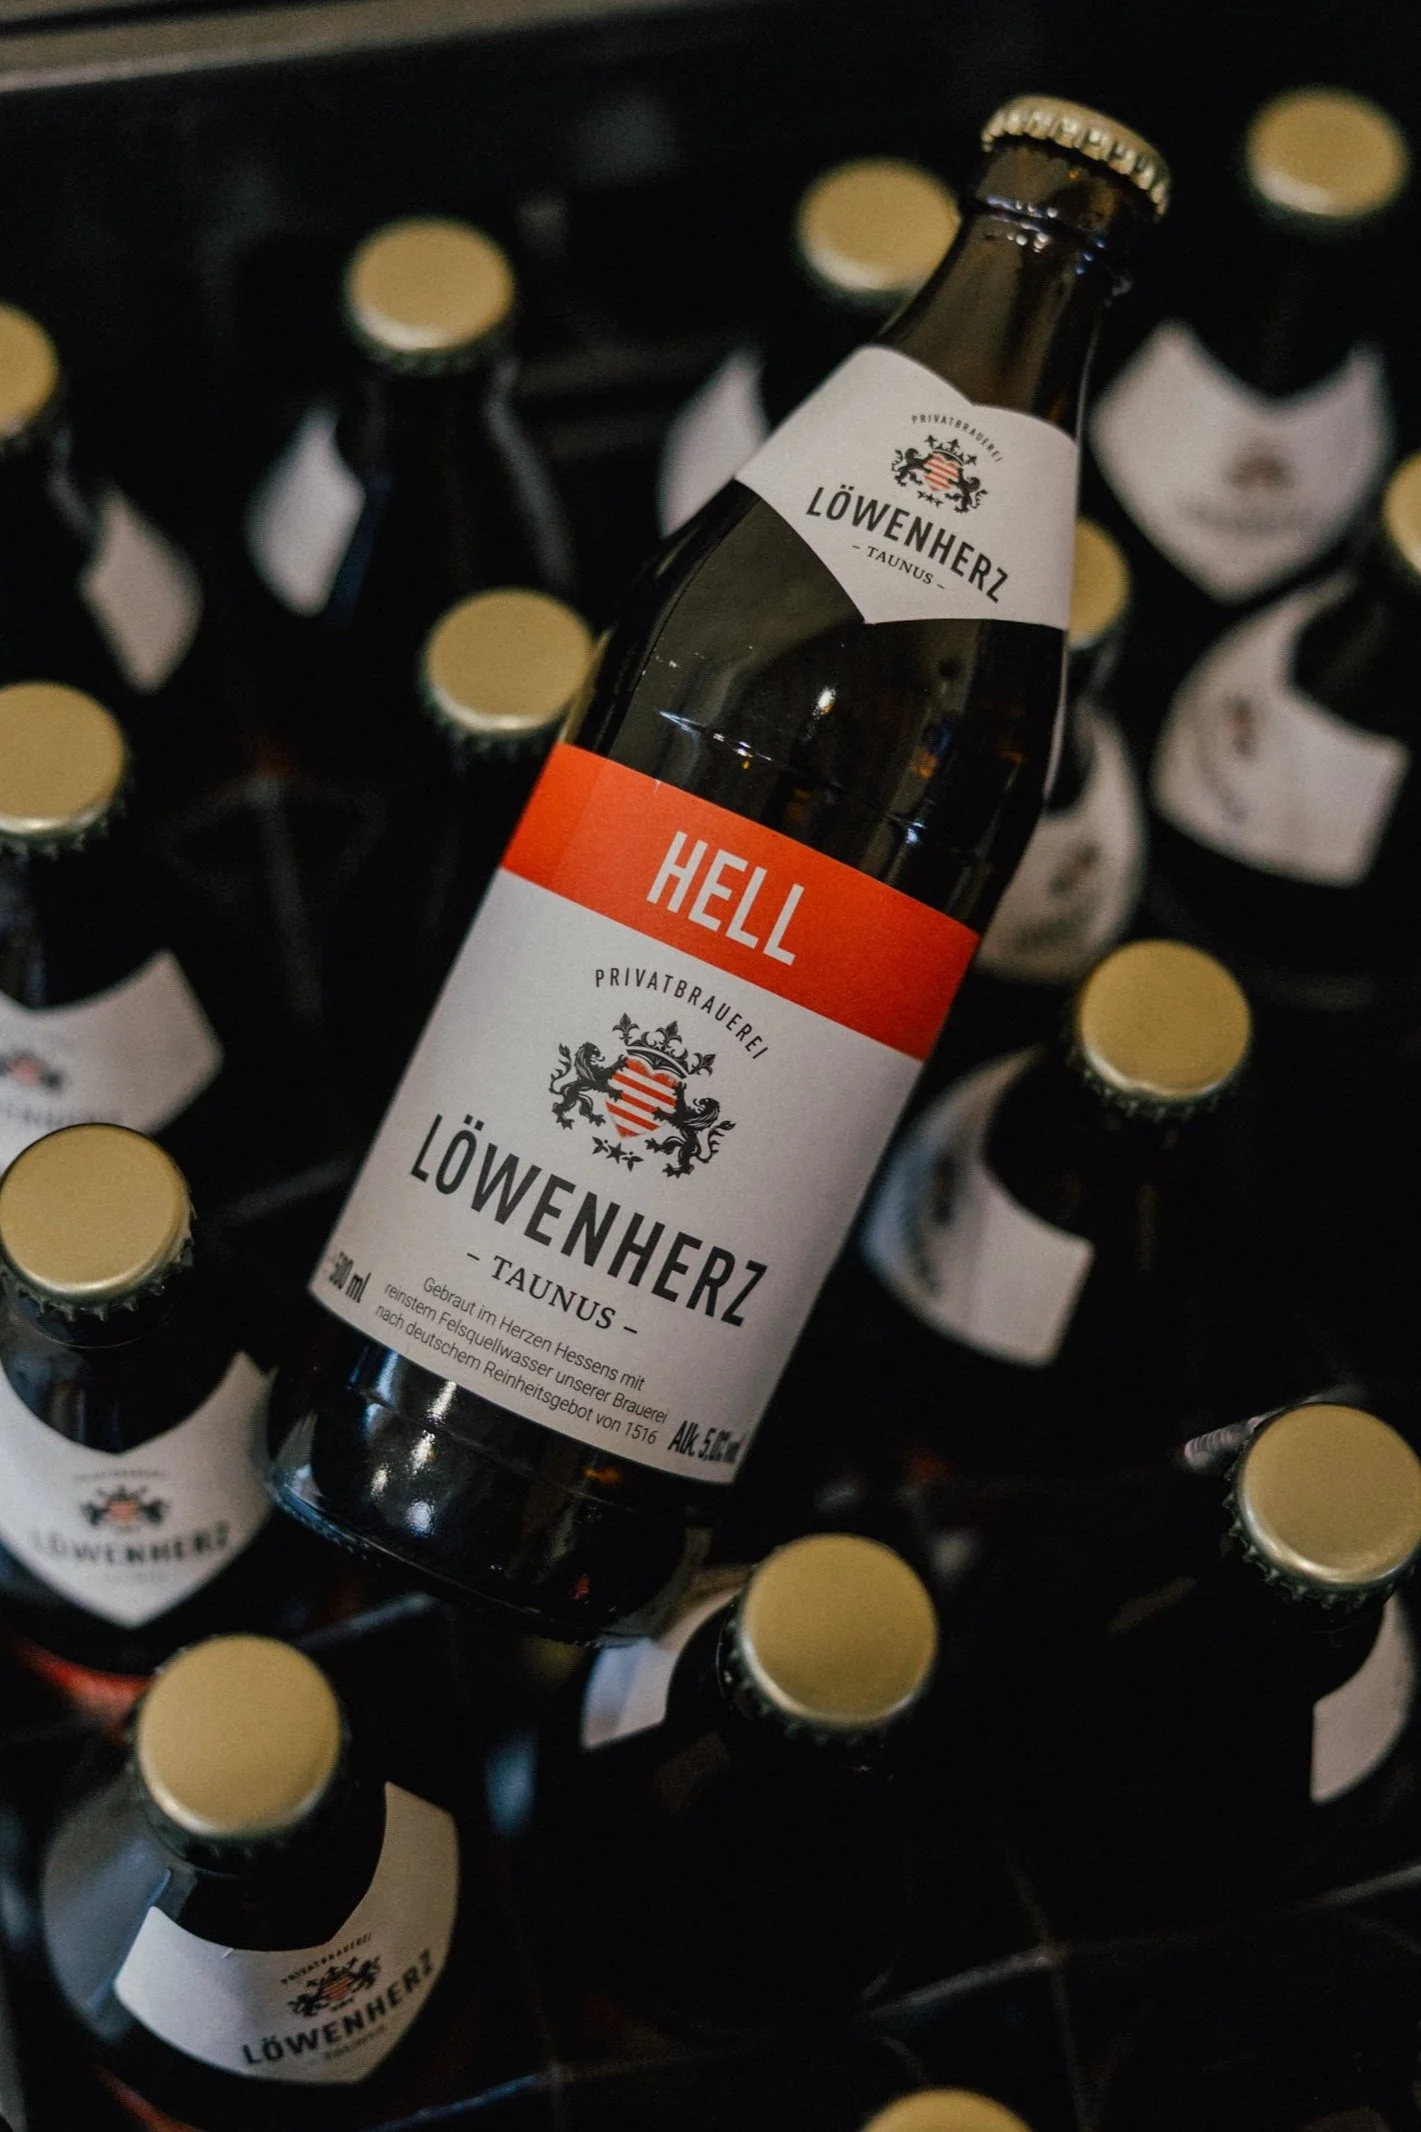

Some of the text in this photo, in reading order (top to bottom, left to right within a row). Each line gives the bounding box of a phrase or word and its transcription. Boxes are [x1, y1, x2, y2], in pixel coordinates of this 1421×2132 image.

[911, 414, 1004, 464] PRIVATBRAUEREI
[806, 484, 1009, 604] LÖWENHERZ
[867, 545, 934, 586] TAUNUS
[646, 830, 805, 966] HELL
[595, 966, 769, 1060] PRIVATBRAUEREI
[409, 1113, 768, 1328] LÖWENHERZ
[345, 1271, 372, 1304] ml
[423, 1277, 646, 1392] Gebraut im Herzen Hessens mit
[491, 1255, 617, 1330] TAUNUS
[375, 1304, 659, 1445] nach deutschem Reinheitsgebot von 1516
[384, 1283, 670, 1425] reinstem Felsquellwasser unserer Brauerei
[241, 1948, 433, 2065] LÖWENHERZ
